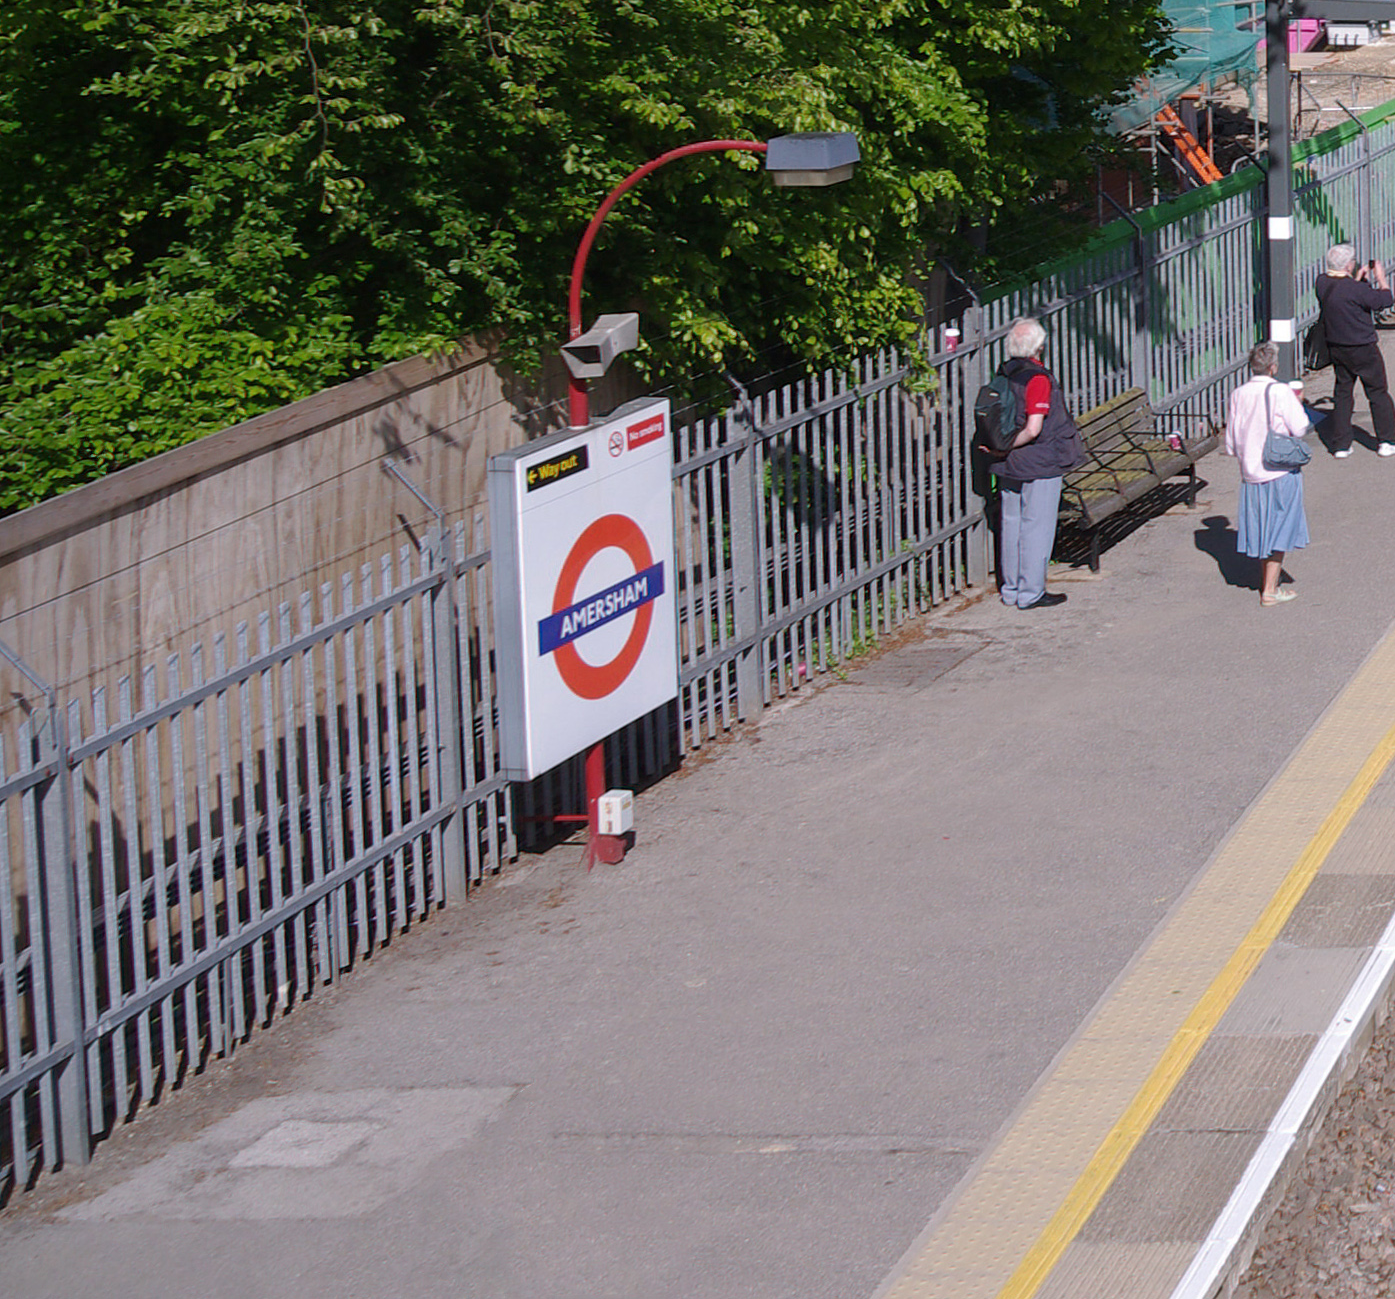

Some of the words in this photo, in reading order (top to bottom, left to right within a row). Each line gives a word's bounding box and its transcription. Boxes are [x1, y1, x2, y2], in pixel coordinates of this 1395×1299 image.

[628, 431, 639, 442] No
[639, 421, 663, 439] smoking
[537, 463, 560, 480] Way
[560, 454, 579, 470] out
[560, 575, 649, 640] AMERSHAM
